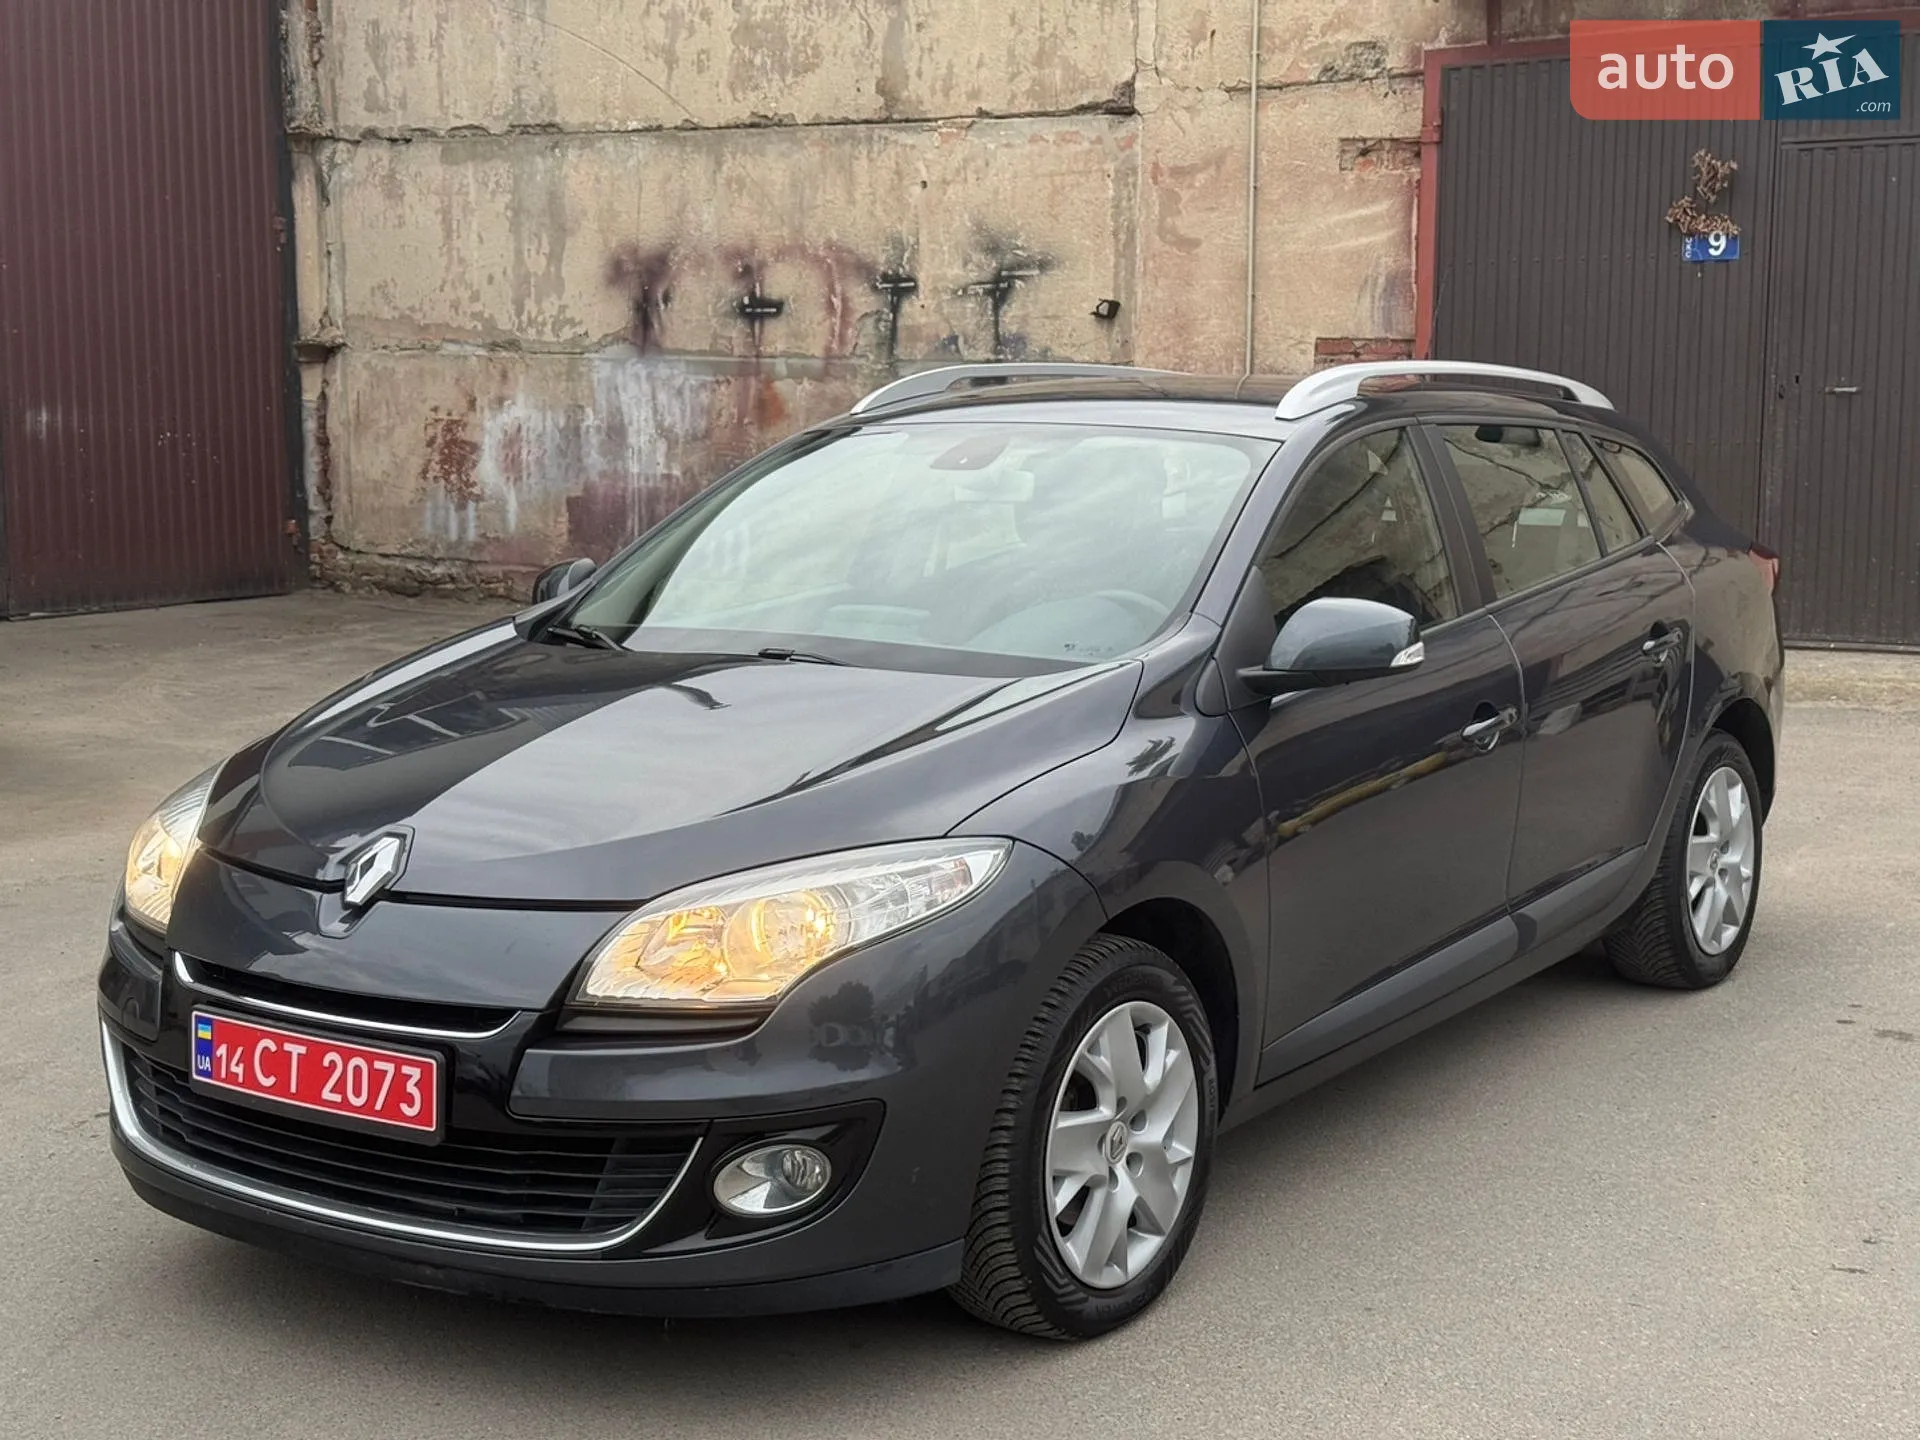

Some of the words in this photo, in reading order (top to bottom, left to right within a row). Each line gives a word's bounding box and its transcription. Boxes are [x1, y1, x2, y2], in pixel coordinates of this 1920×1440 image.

[1708, 230, 1727, 256] 9
[197, 1054, 212, 1072] UA
[321, 1051, 423, 1118] 2073
